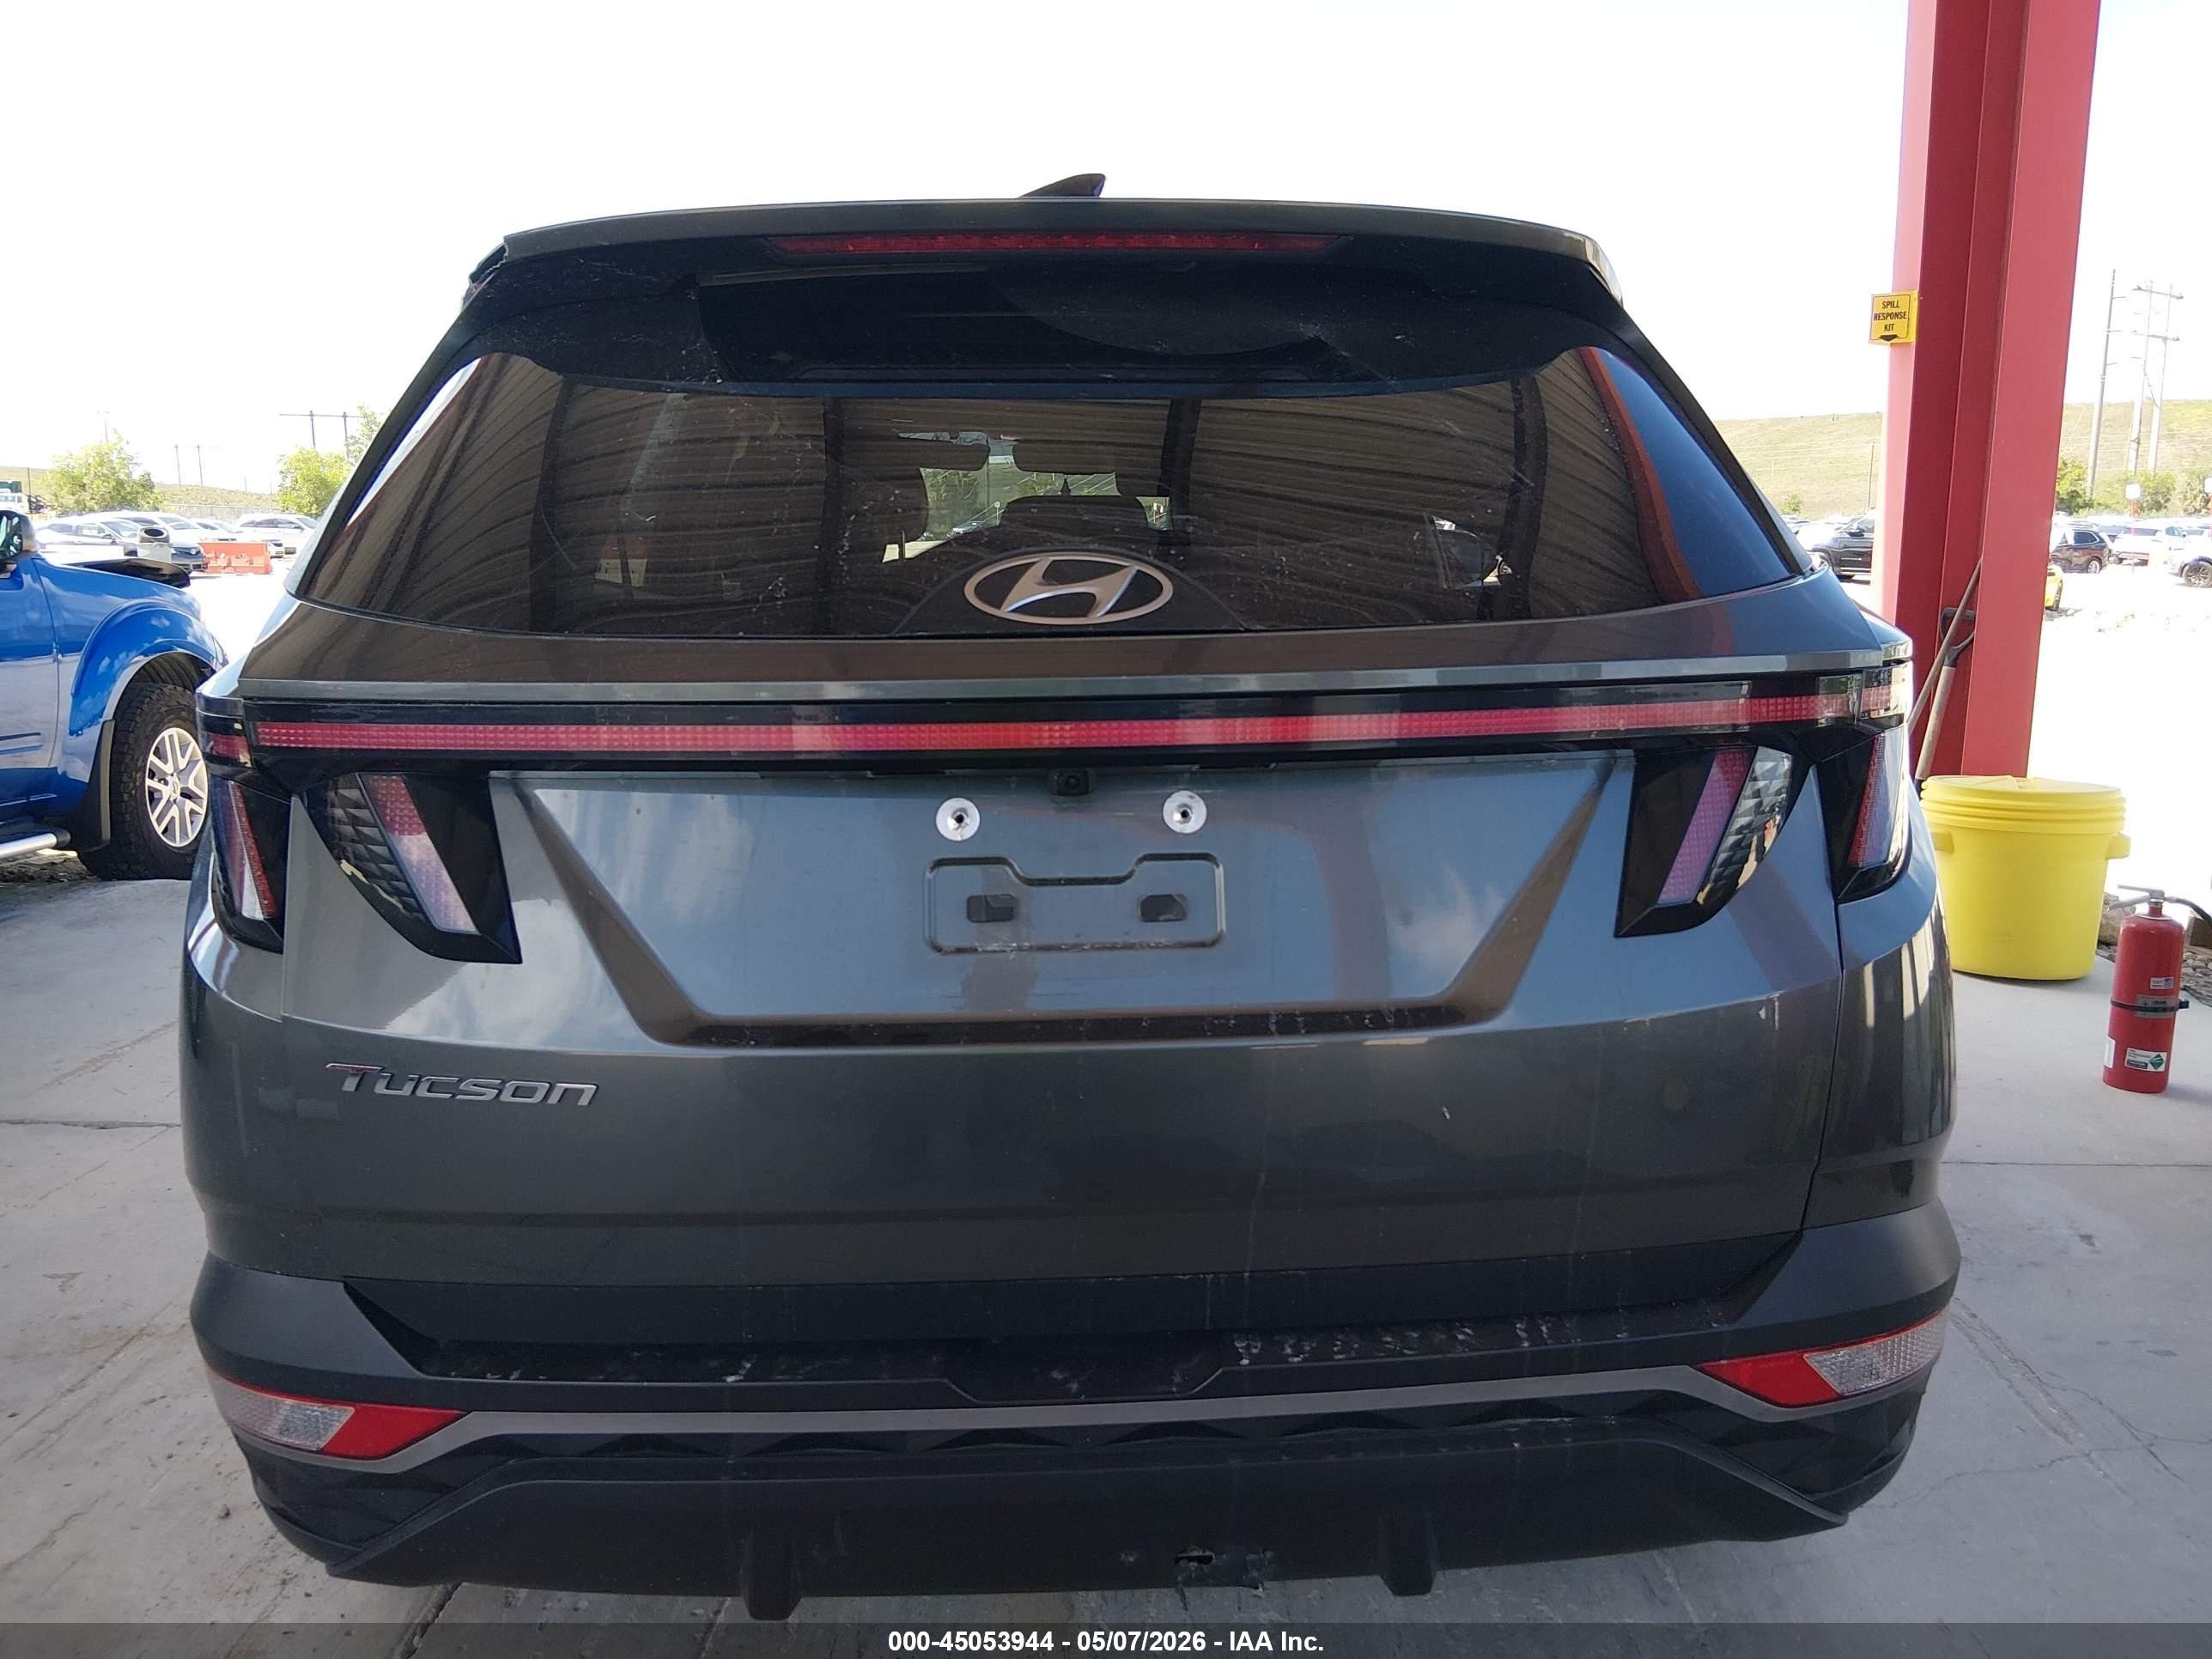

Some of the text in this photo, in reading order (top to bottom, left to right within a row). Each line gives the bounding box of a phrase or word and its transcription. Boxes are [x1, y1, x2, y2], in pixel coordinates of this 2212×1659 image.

[1882, 301, 1900, 309] SPILL
[1874, 311, 1907, 321] RESPONSE
[1884, 323, 1895, 332] KIT
